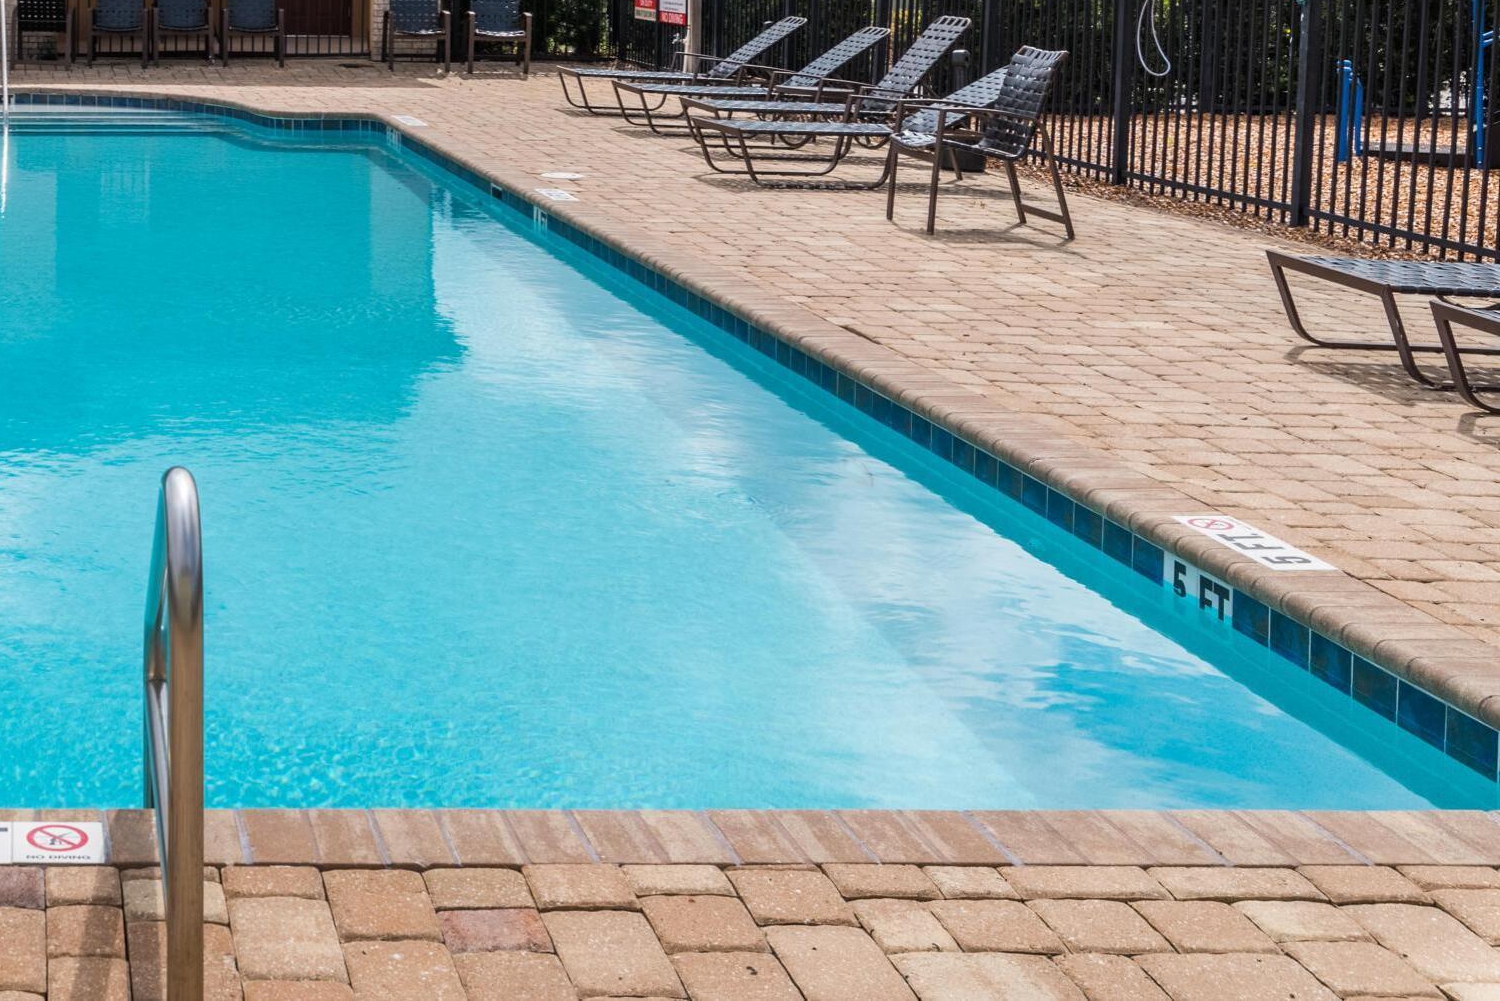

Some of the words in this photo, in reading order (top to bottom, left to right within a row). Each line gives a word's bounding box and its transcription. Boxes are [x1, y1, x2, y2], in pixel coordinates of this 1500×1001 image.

[1261, 556, 1312, 564] 5
[1173, 560, 1187, 597] 5
[1200, 574, 1230, 621] FT
